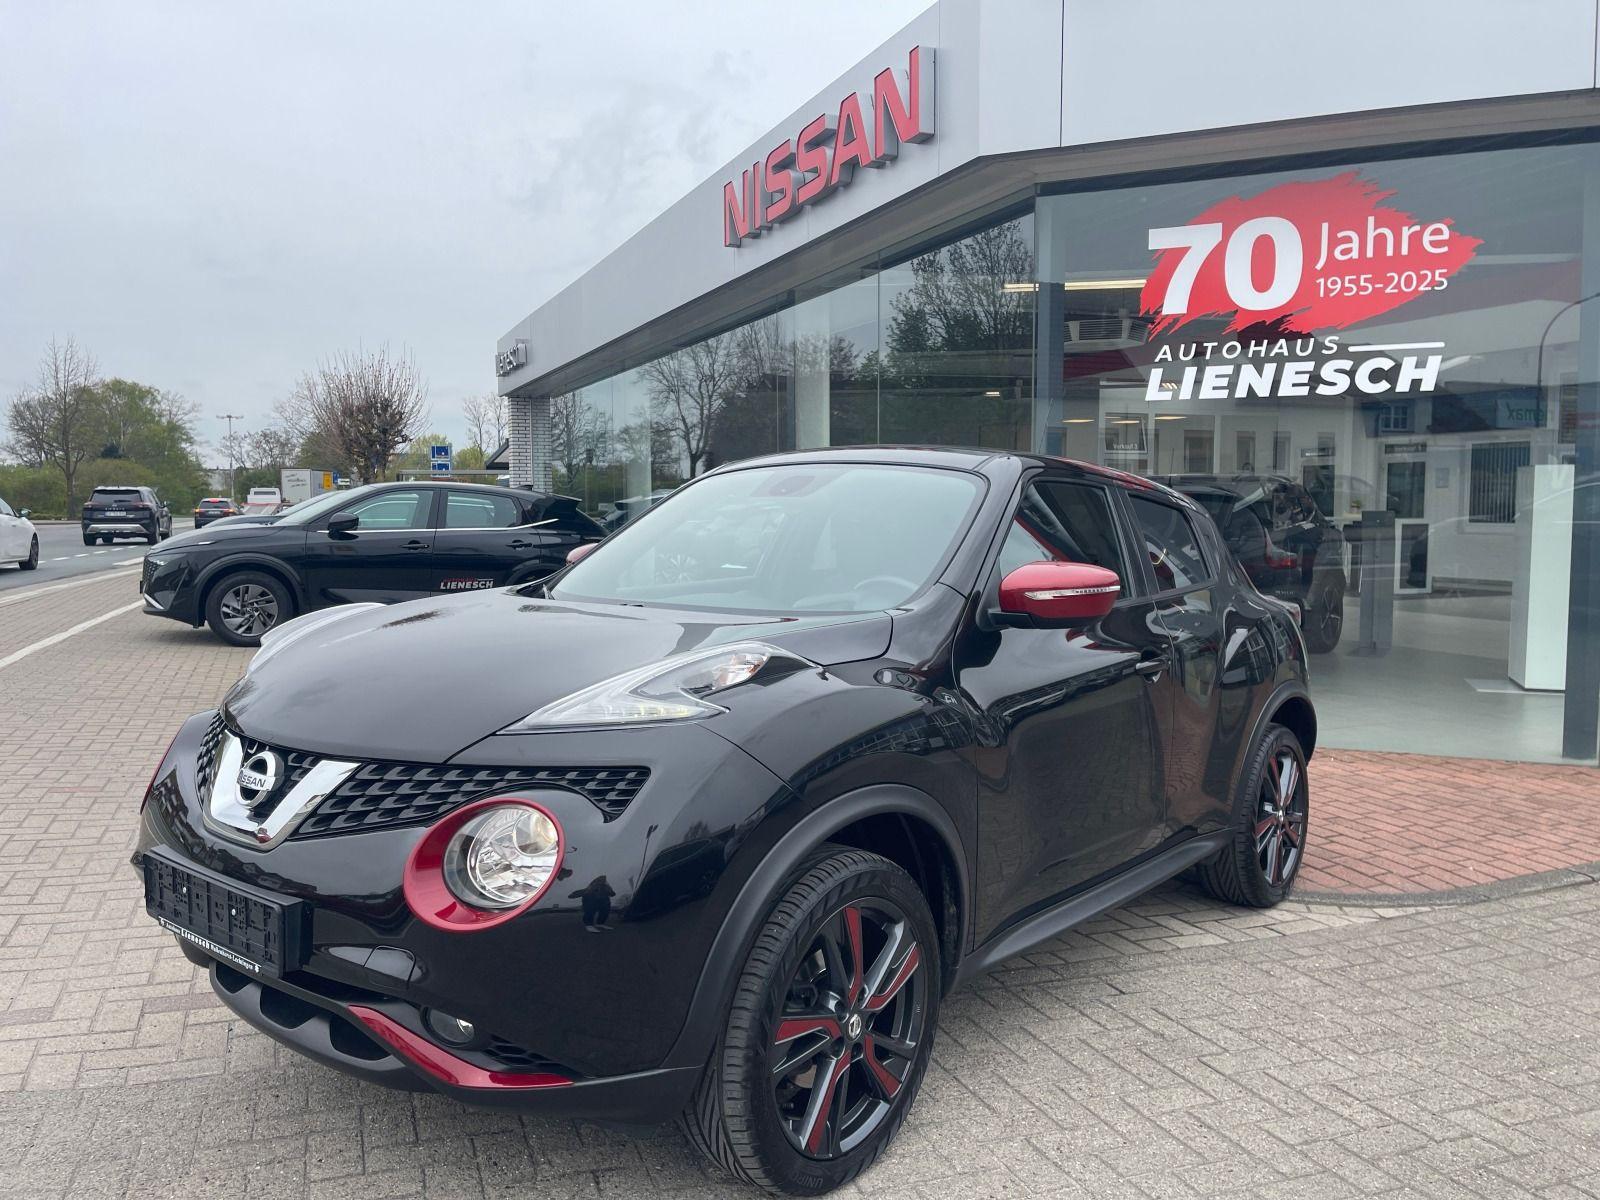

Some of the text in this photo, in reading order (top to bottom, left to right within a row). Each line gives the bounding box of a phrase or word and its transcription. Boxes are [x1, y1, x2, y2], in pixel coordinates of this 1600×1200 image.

[724, 45, 932, 248] NISSAN
[1148, 216, 1450, 315] 70 Jahre
[1315, 269, 1448, 298] 1955-2025
[1154, 336, 1340, 363] AUTOHAUS
[1145, 355, 1442, 401] LIENESCH
[440, 581, 494, 590] LIENESCH
